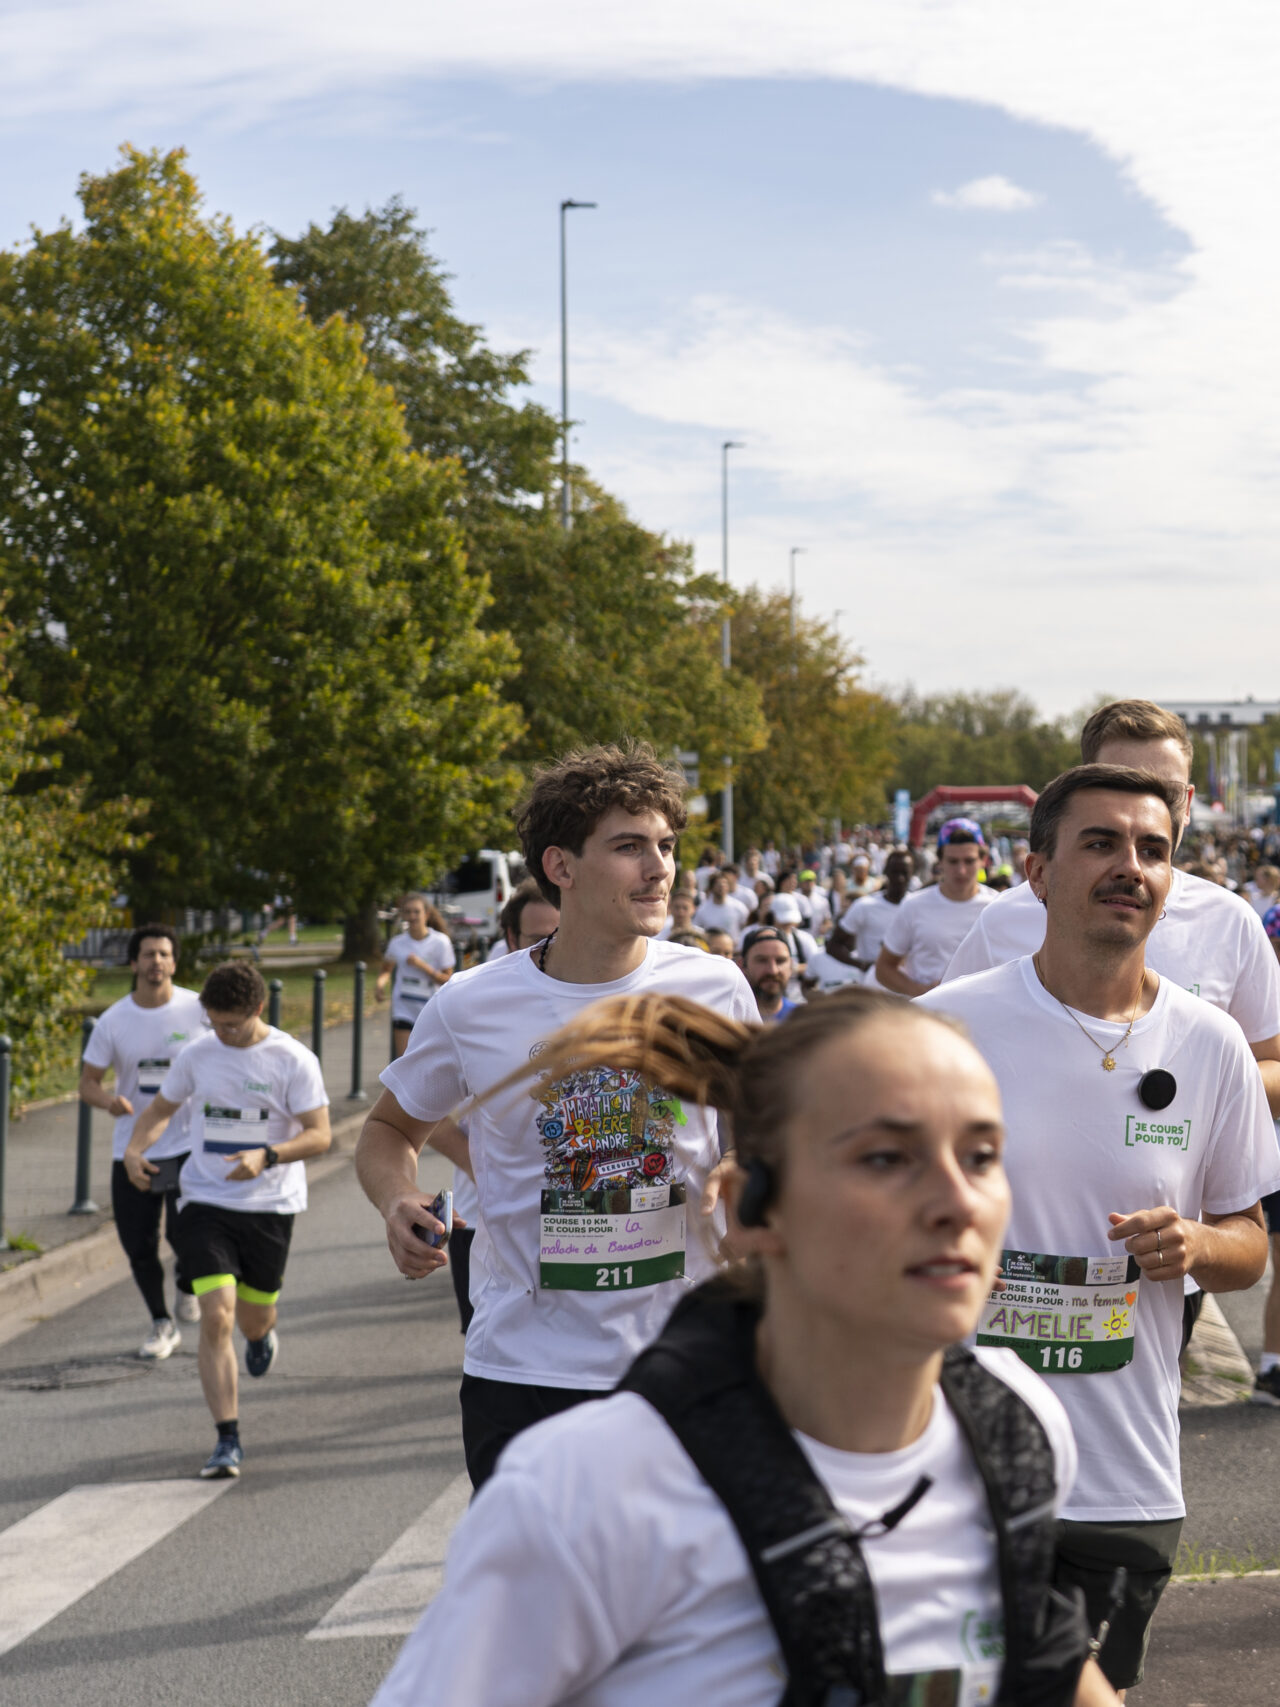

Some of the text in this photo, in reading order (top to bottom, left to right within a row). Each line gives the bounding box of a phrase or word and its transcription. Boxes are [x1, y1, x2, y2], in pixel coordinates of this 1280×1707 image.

[566, 1094, 630, 1125] MARATHON
[1135, 1122, 1184, 1135] JE COURS
[1135, 1133, 1184, 1146] POUR TOI
[543, 1217, 579, 1225] COURSE
[543, 1225, 554, 1233] JE
[584, 1243, 599, 1254] de
[596, 1265, 633, 1287] 211
[1030, 1286, 1041, 1294] 10
[1044, 1288, 1059, 1296] KM
[1000, 1293, 1034, 1303] COURS
[1036, 1297, 1064, 1306] POUR
[1071, 1293, 1125, 1307] ma femme
[988, 1308, 1093, 1341] AMELIE
[1040, 1347, 1083, 1368] 116
